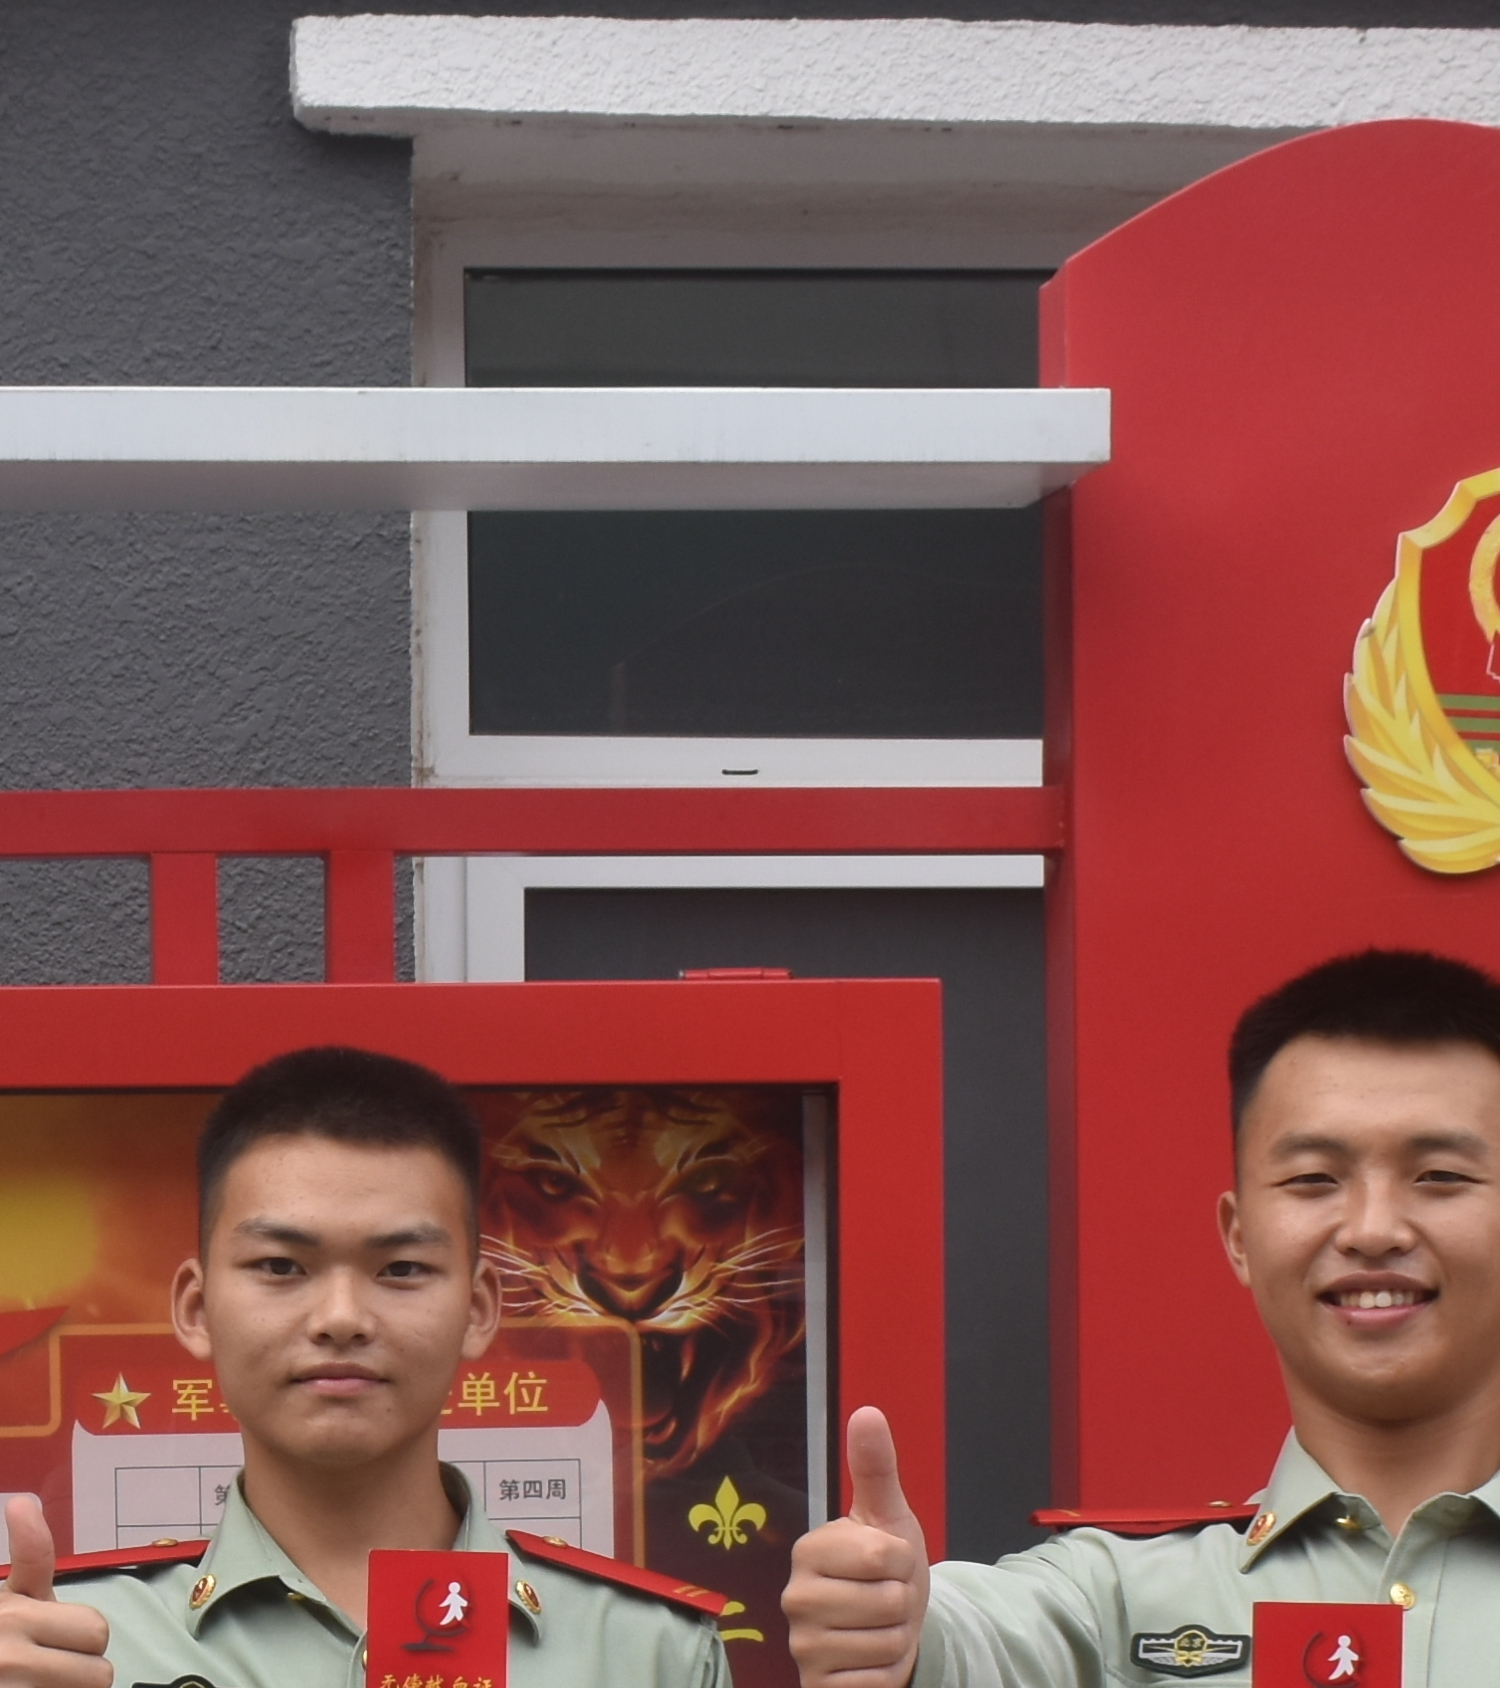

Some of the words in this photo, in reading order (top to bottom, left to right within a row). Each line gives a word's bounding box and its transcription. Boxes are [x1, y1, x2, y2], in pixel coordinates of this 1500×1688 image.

[439, 1370, 550, 1417] 单位
[498, 1479, 567, 1502] 第四周
